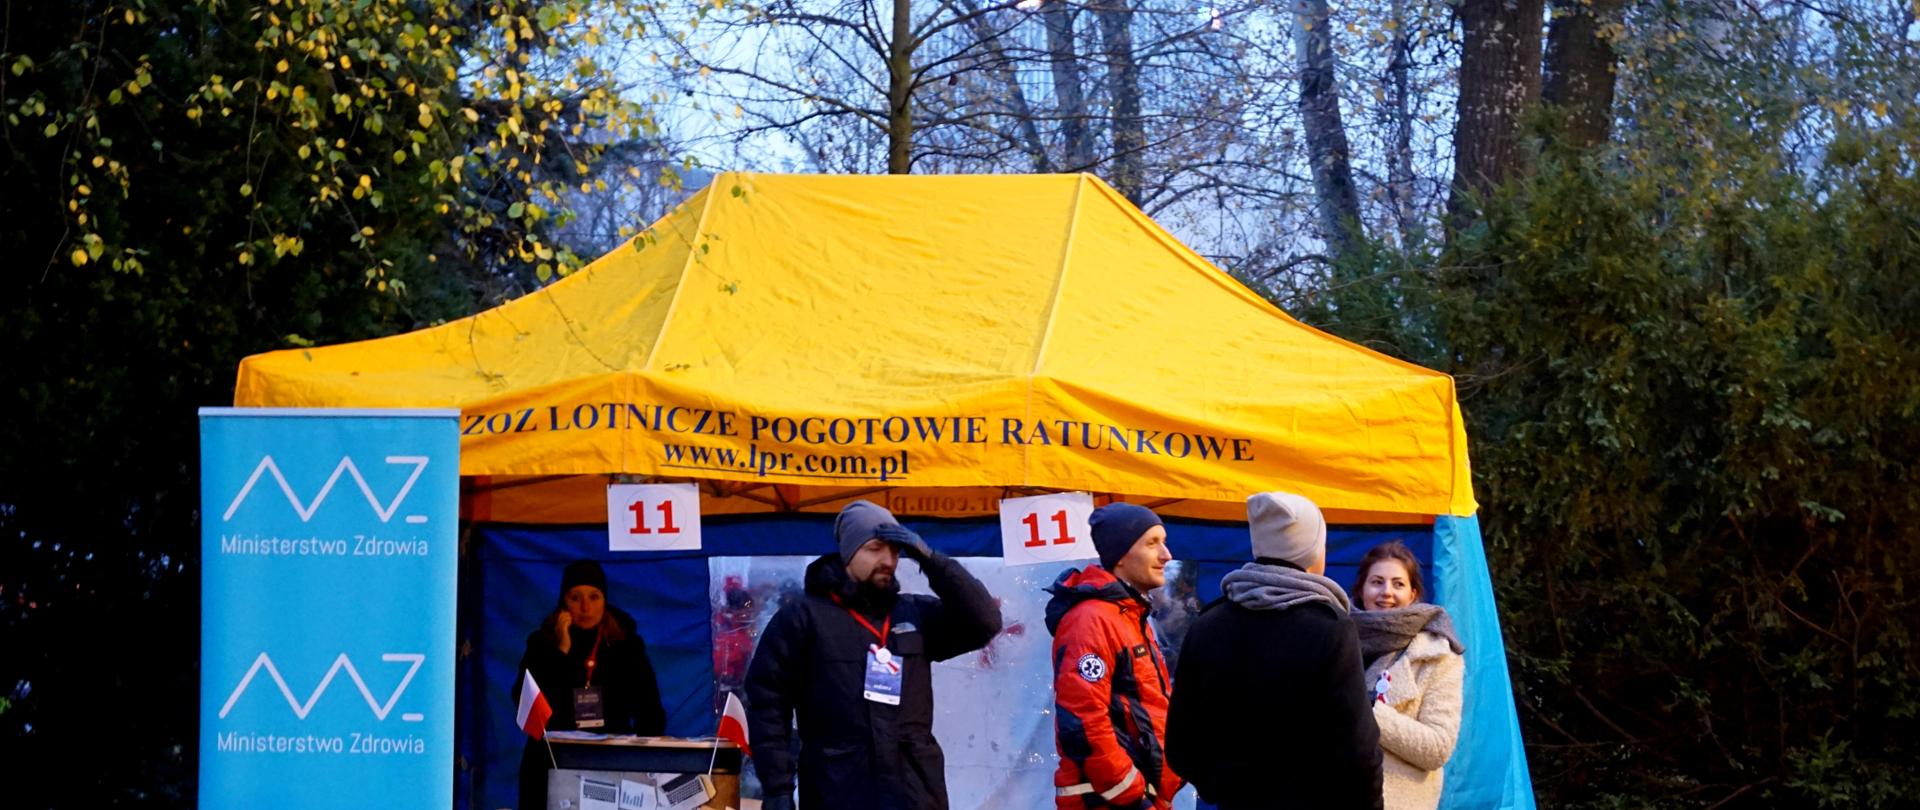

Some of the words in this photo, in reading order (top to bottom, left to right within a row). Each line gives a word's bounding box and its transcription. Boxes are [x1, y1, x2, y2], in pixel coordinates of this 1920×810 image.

[463, 411, 537, 436] ZOZ
[550, 403, 738, 437] LOTNICZE
[751, 416, 988, 445] POGOTOWIE
[1001, 418, 1255, 462] RATUNKOWE
[664, 443, 909, 481] www.lpr.com.pl
[628, 500, 680, 534] 11
[1022, 510, 1076, 548] 11
[221, 534, 346, 555] Ministerstwo
[352, 535, 428, 556] Zdrowia
[217, 732, 342, 754] Ministerstwo
[349, 733, 425, 754] Zdrowia
